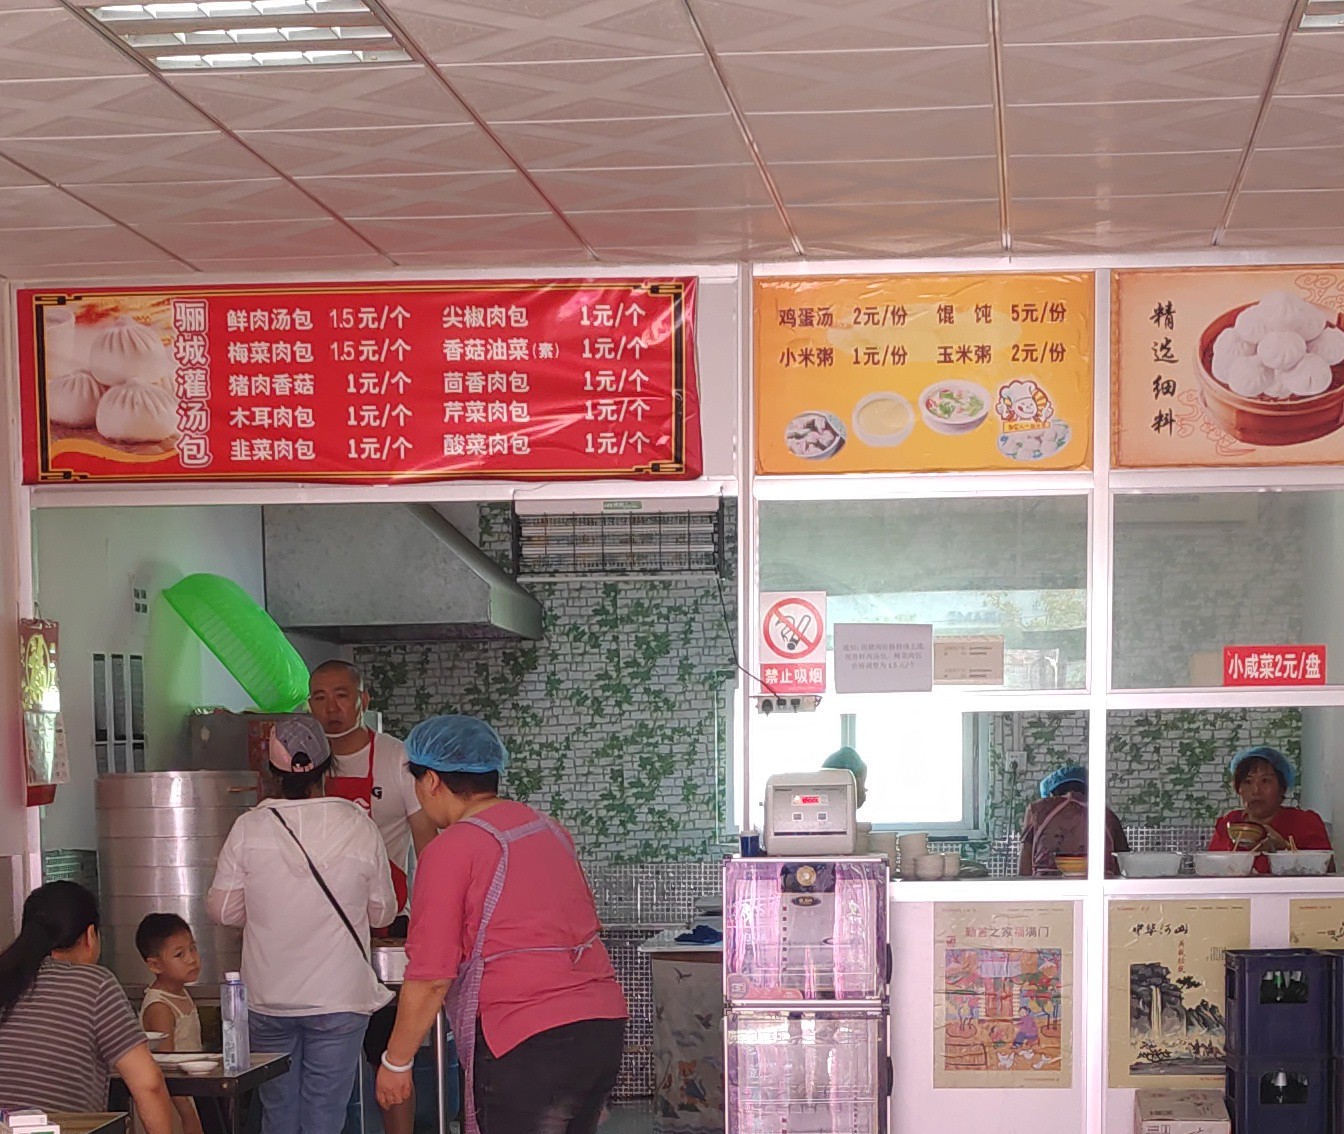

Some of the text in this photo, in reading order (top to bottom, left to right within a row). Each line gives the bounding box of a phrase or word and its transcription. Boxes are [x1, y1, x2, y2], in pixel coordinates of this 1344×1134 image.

[227, 303, 646, 332] 鲜肉汤包 1.5元/个 尖椒肉包 1元/个
[779, 306, 833, 328] 鸡蛋汤
[853, 305, 908, 326] 2元/份
[1011, 303, 1067, 324] 5元/份
[227, 341, 314, 364] 梅菜肉包
[329, 339, 411, 362] 1.5元/个
[582, 337, 647, 361] 1元/个
[779, 342, 1067, 368] 小米粥 1元/份 玉米粥 2元/份
[174, 300, 212, 467] 骊城灌汤包
[229, 369, 649, 396] 猪肉香菇 1元/个 茴香肉包 1元/个
[1149, 301, 1180, 438] 精选细料
[229, 399, 649, 429] 木耳肉包 1元/个 芹菜肉包 1元/个
[230, 431, 650, 462] 韭菜肉包 1元/个 酸菜肉包 1元/个
[764, 666, 824, 685] 禁止吸烟
[1227, 651, 1322, 681] 小咸菜2元/盘
